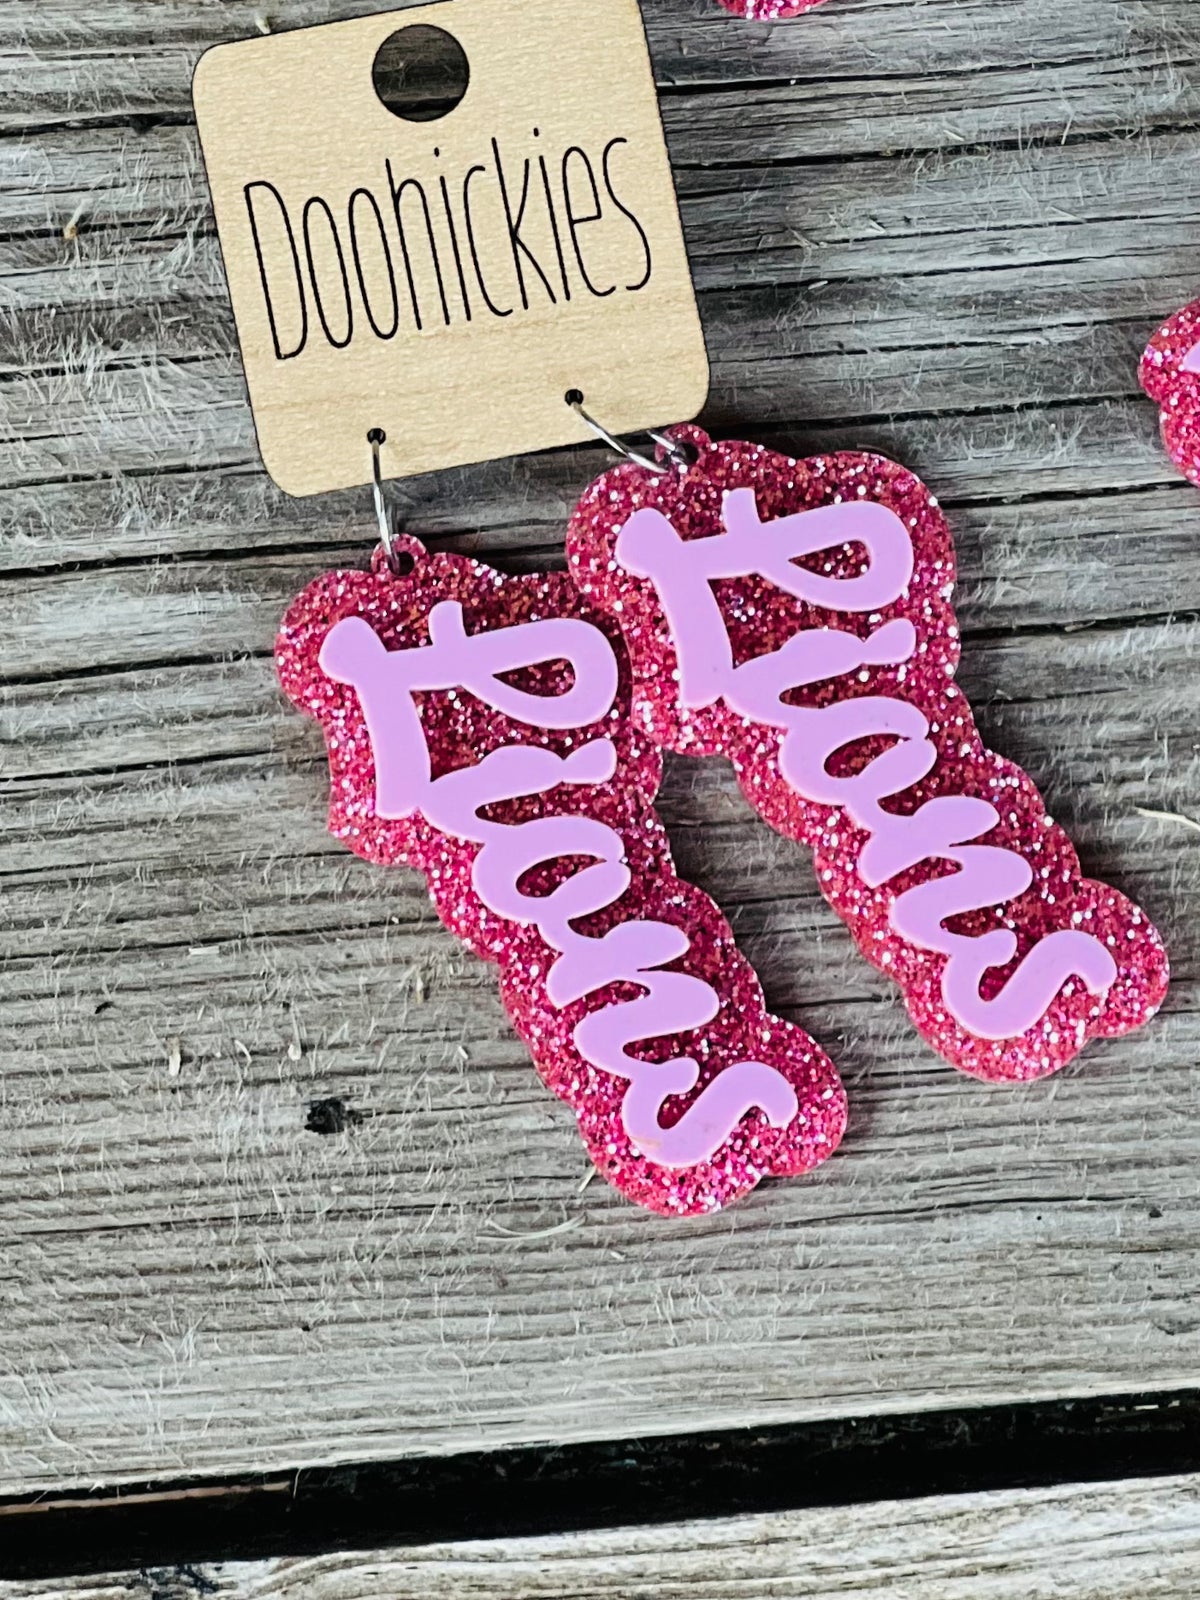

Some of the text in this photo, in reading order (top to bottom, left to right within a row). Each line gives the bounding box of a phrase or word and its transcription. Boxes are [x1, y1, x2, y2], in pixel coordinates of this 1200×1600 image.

[243, 127, 652, 361] Doohickies
[320, 601, 797, 1167] Lions
[616, 489, 1118, 1038] Lions
